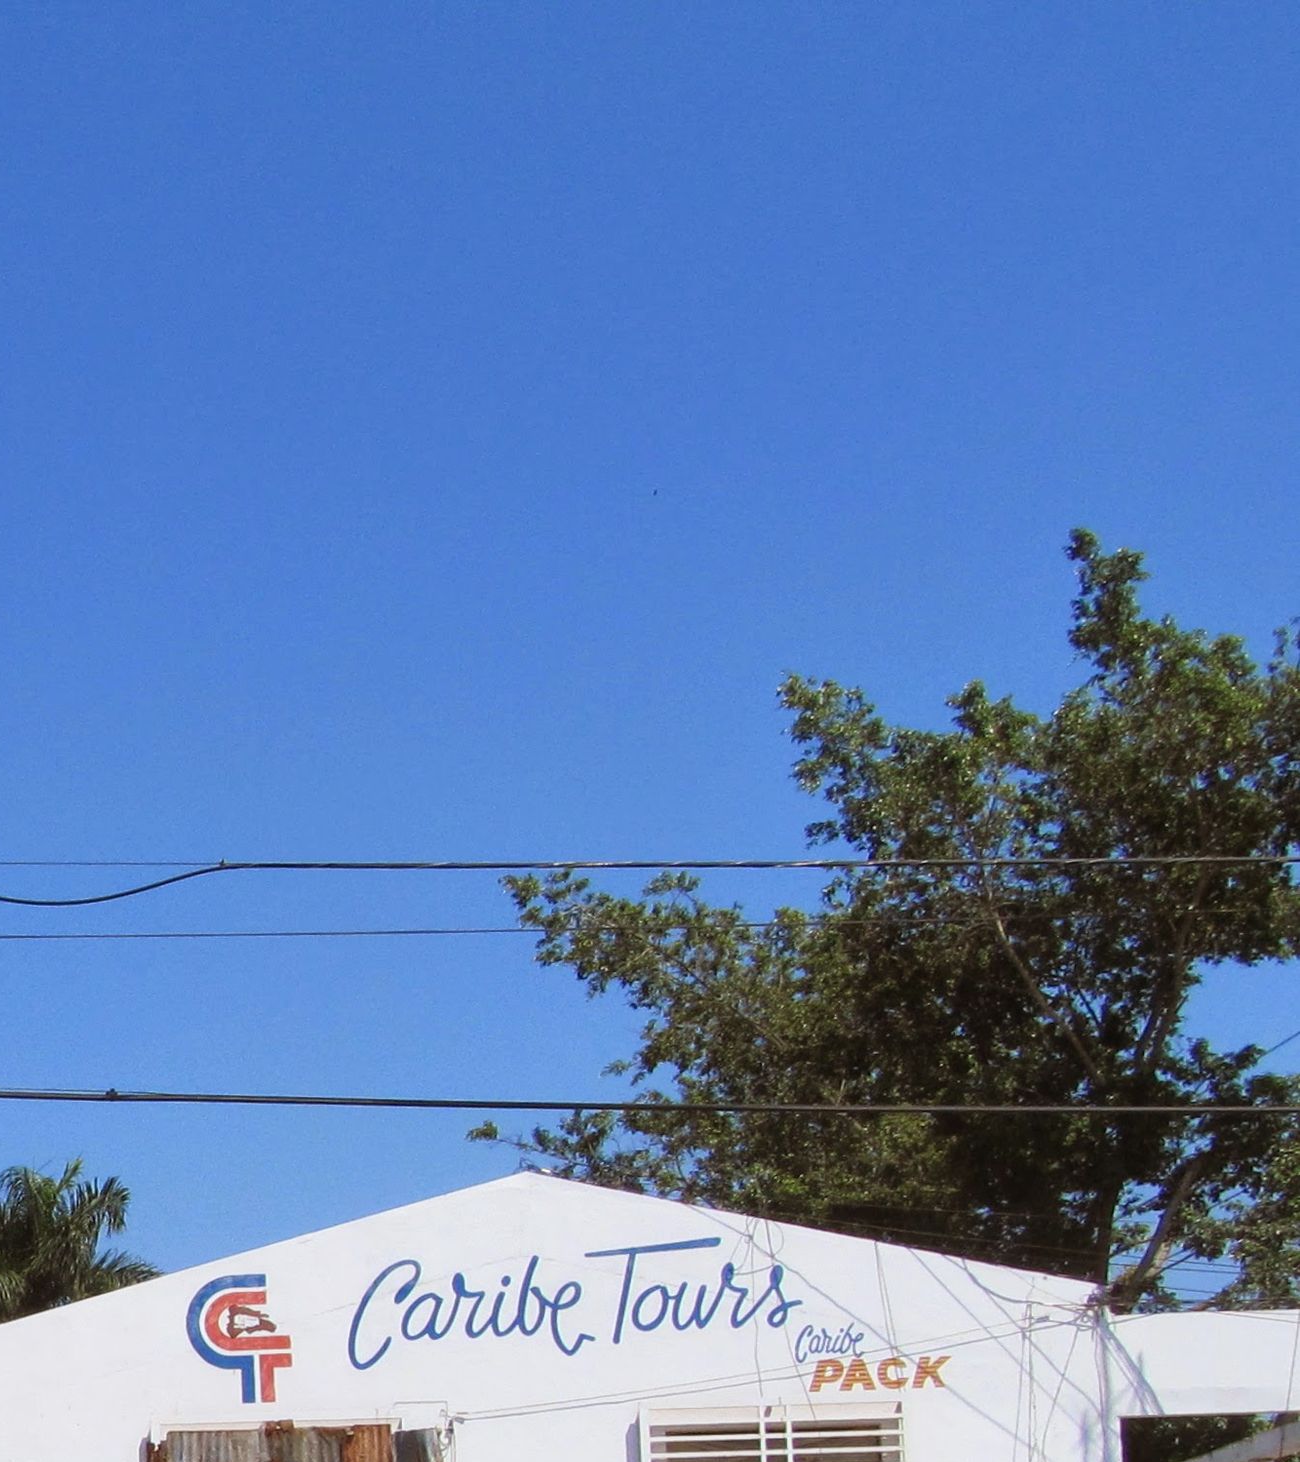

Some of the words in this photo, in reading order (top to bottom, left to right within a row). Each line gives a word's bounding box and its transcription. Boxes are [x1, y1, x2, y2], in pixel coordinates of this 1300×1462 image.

[348, 1256, 596, 1370] Caribe
[584, 1237, 803, 1344] Tours
[795, 1322, 865, 1364] Caribe
[809, 1356, 951, 1392] PACK
